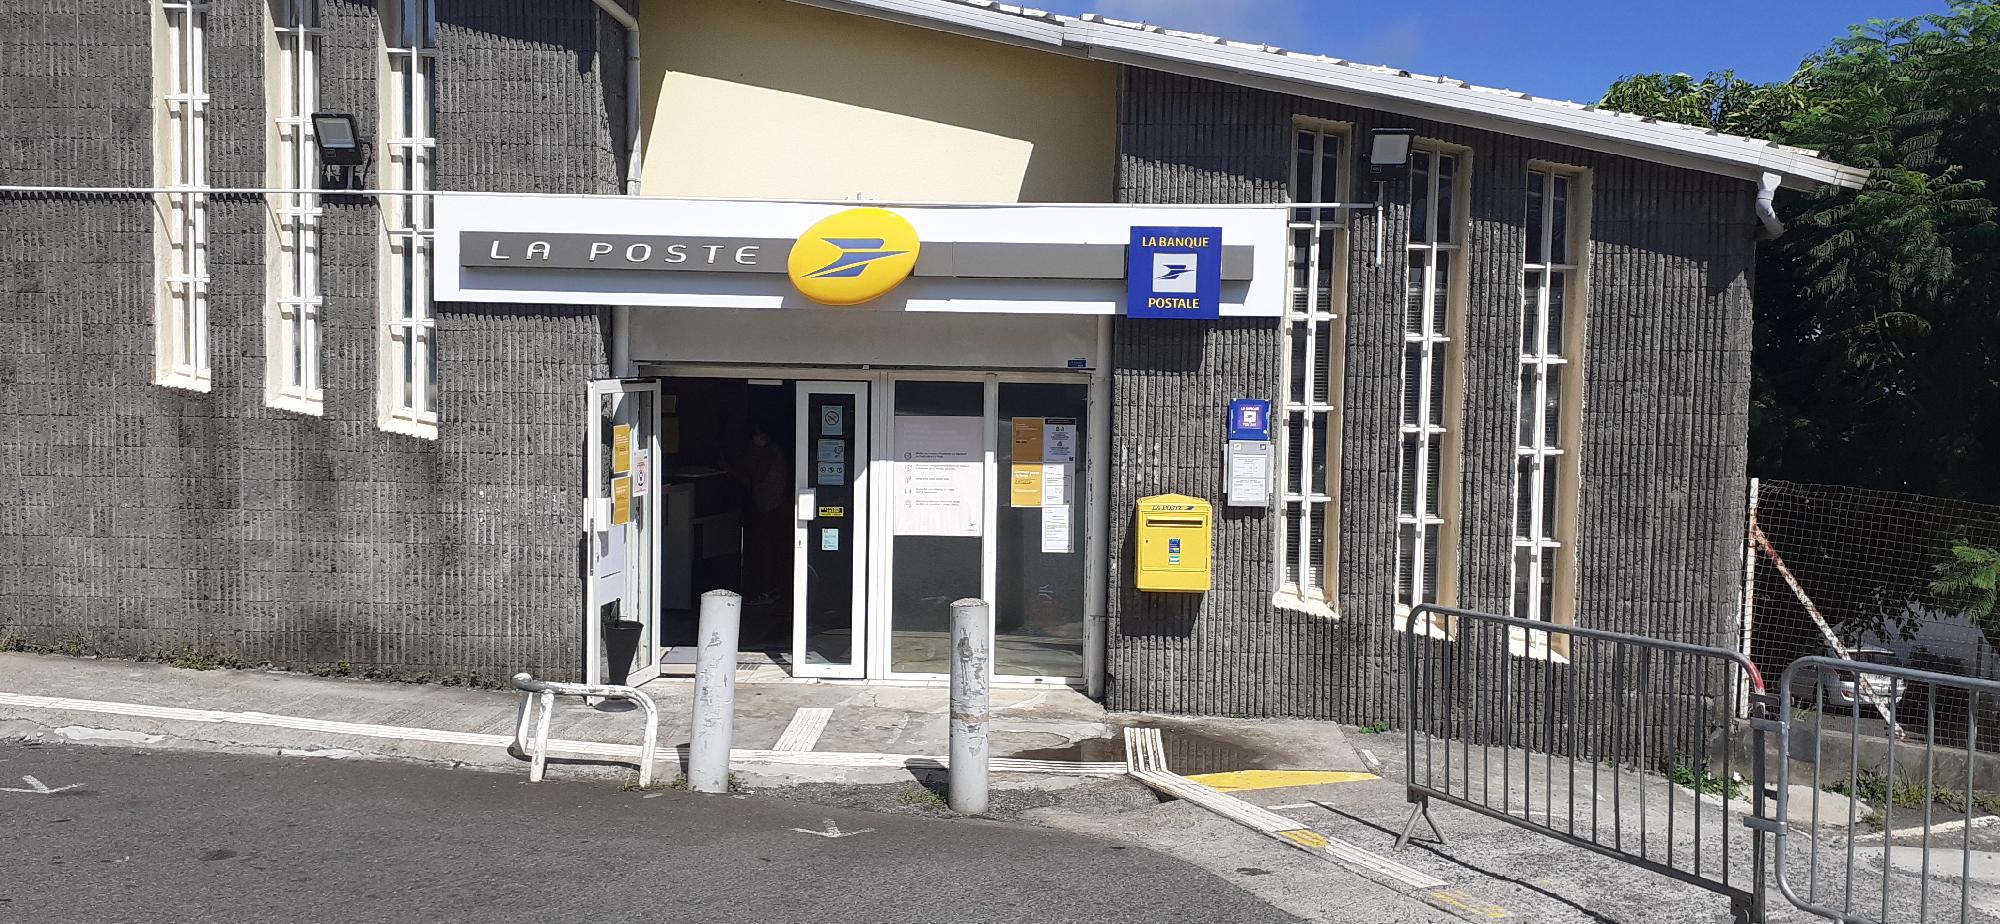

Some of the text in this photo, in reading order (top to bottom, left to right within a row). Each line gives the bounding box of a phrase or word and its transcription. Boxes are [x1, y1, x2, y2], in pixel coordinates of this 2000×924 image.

[1142, 236, 1209, 249] LA BANQUE
[490, 240, 760, 265] LA POSTE
[1148, 297, 1200, 309] POSTALE
